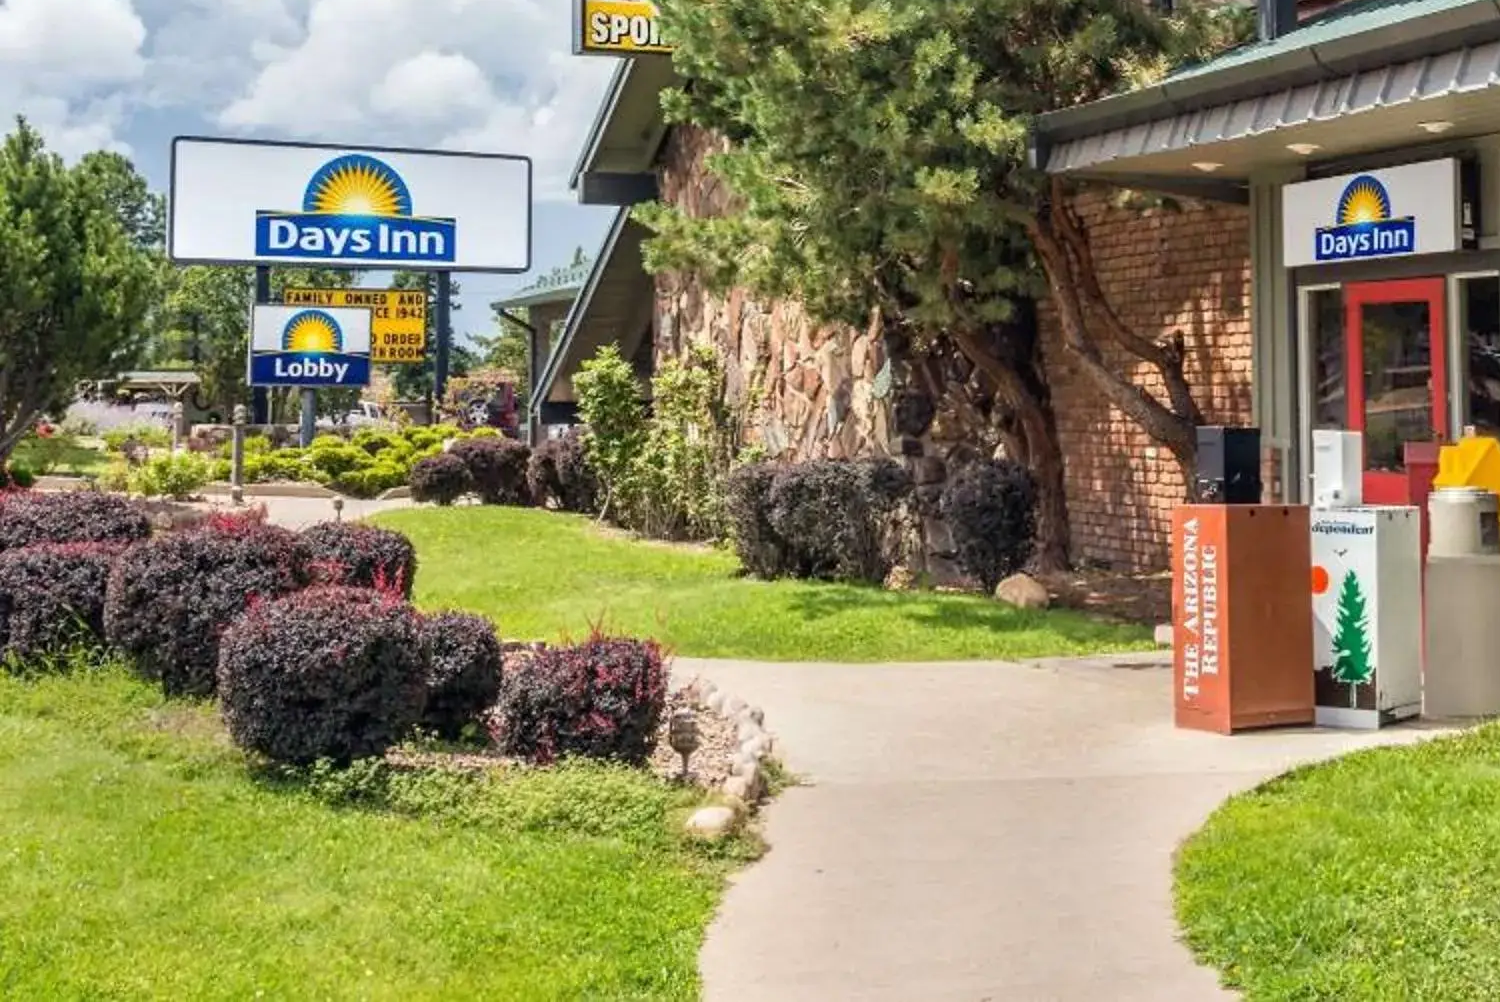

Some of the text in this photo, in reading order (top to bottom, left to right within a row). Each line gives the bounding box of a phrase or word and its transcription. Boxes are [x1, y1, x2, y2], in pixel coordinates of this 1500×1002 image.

[269, 219, 445, 255] Days Inn
[1321, 227, 1409, 256] Days Inn
[286, 292, 333, 304] FAMILY
[398, 294, 423, 306] AND
[384, 333, 421, 345] ORDER
[275, 357, 349, 383] Lobby
[1311, 522, 1374, 535] dependent
[1183, 517, 1199, 701] THE ARIZONA
[1202, 545, 1218, 675] REPUBLIC
